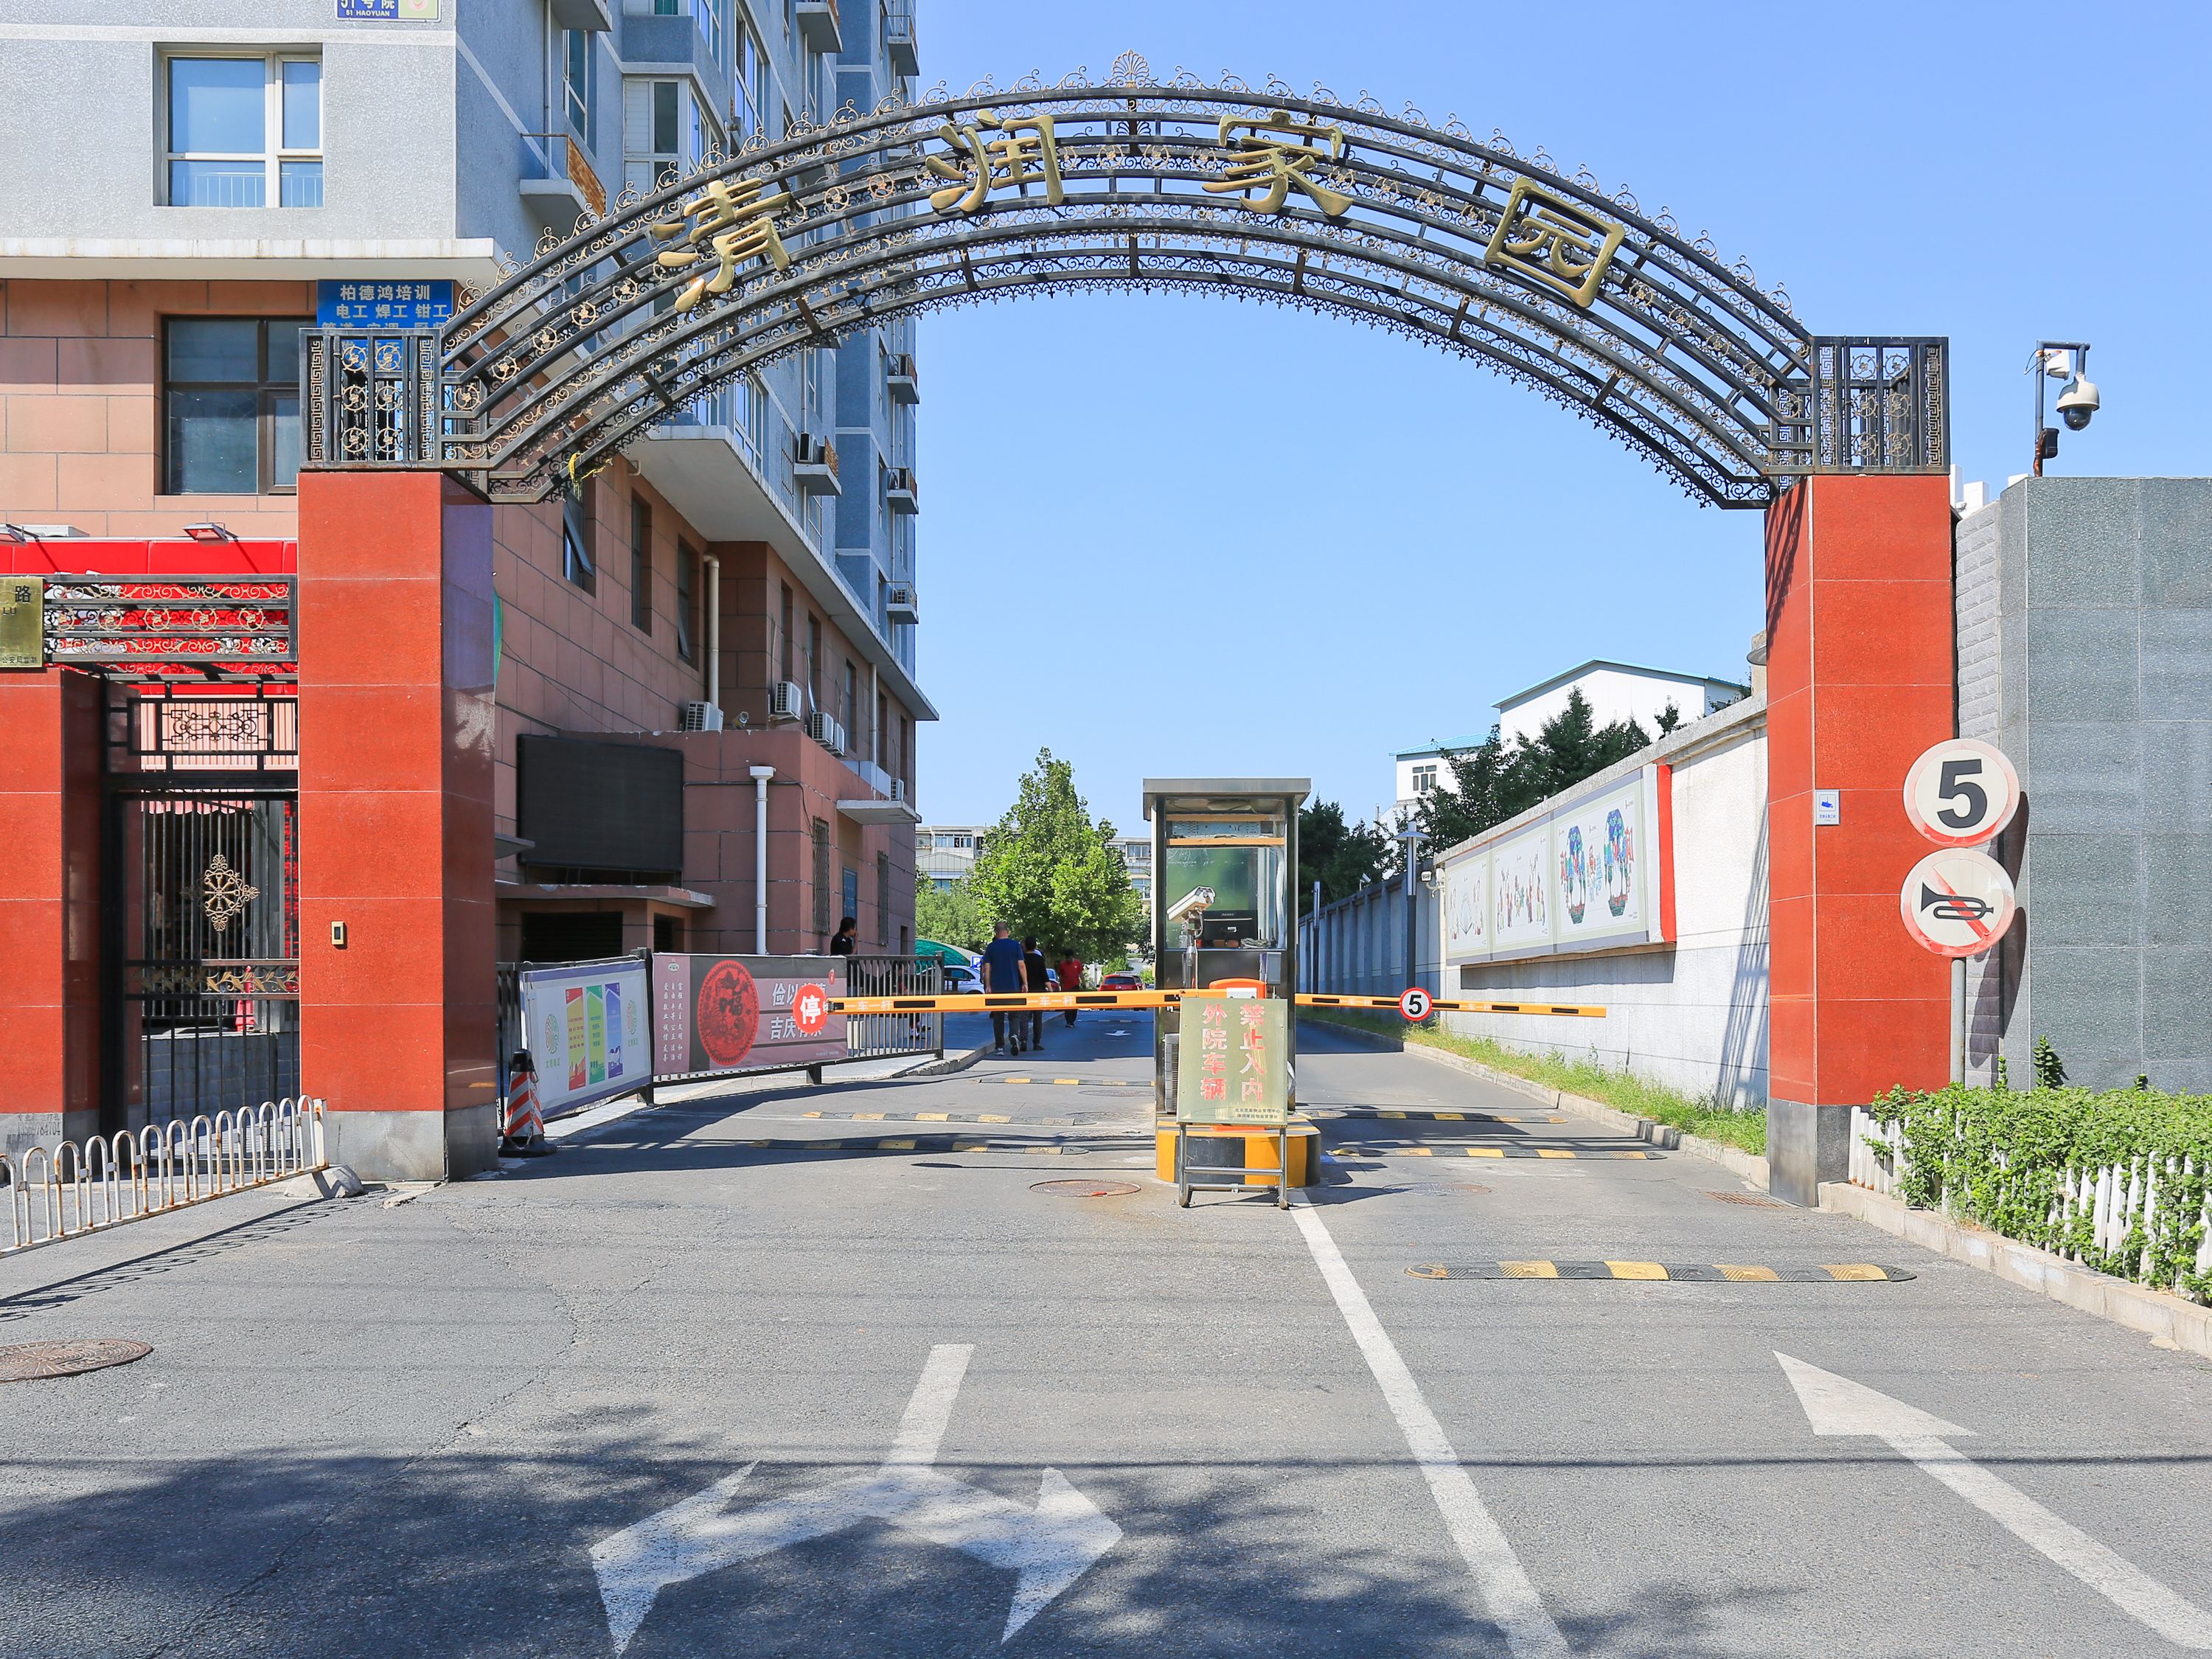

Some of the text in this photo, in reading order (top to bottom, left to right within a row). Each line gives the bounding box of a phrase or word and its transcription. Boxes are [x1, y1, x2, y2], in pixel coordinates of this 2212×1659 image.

[340, 285, 430, 301] 柏德鸿培训
[336, 304, 448, 319] 电工 焊工 钳工
[15, 585, 31, 603] 路
[3, 607, 17, 615] LU
[1936, 759, 1988, 829] 5
[800, 994, 821, 1025] 停
[845, 1000, 893, 1011] 一车一杆
[1028, 995, 1074, 1006] 一车一杆
[1408, 994, 1422, 1015] 5
[1200, 1003, 1228, 1102] 外院车辆
[1239, 1004, 1267, 1103] 禁止入内
